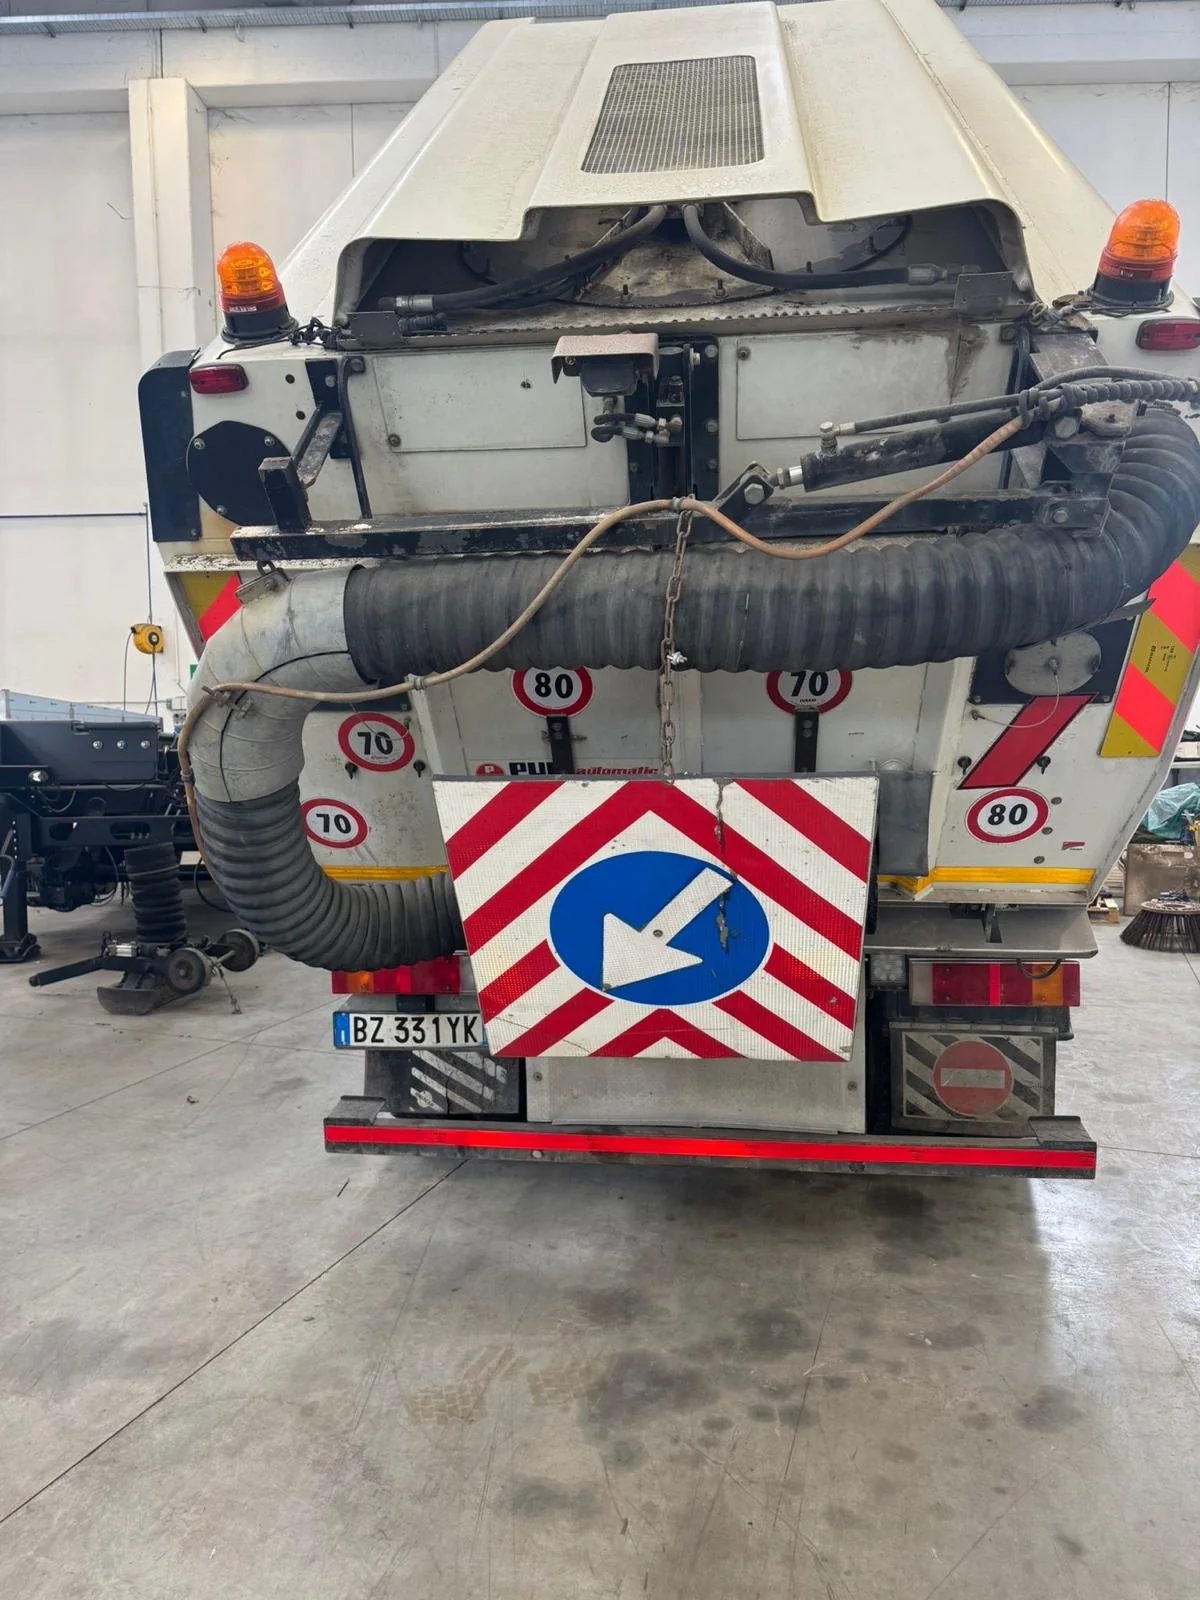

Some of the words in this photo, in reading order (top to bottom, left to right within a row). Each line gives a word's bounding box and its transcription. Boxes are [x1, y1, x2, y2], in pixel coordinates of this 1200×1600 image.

[535, 672, 573, 699] 80
[791, 671, 829, 697] 70
[357, 731, 393, 755] 70
[316, 813, 352, 834] 70
[987, 803, 1028, 826] 80
[354, 1016, 384, 1043] BZ
